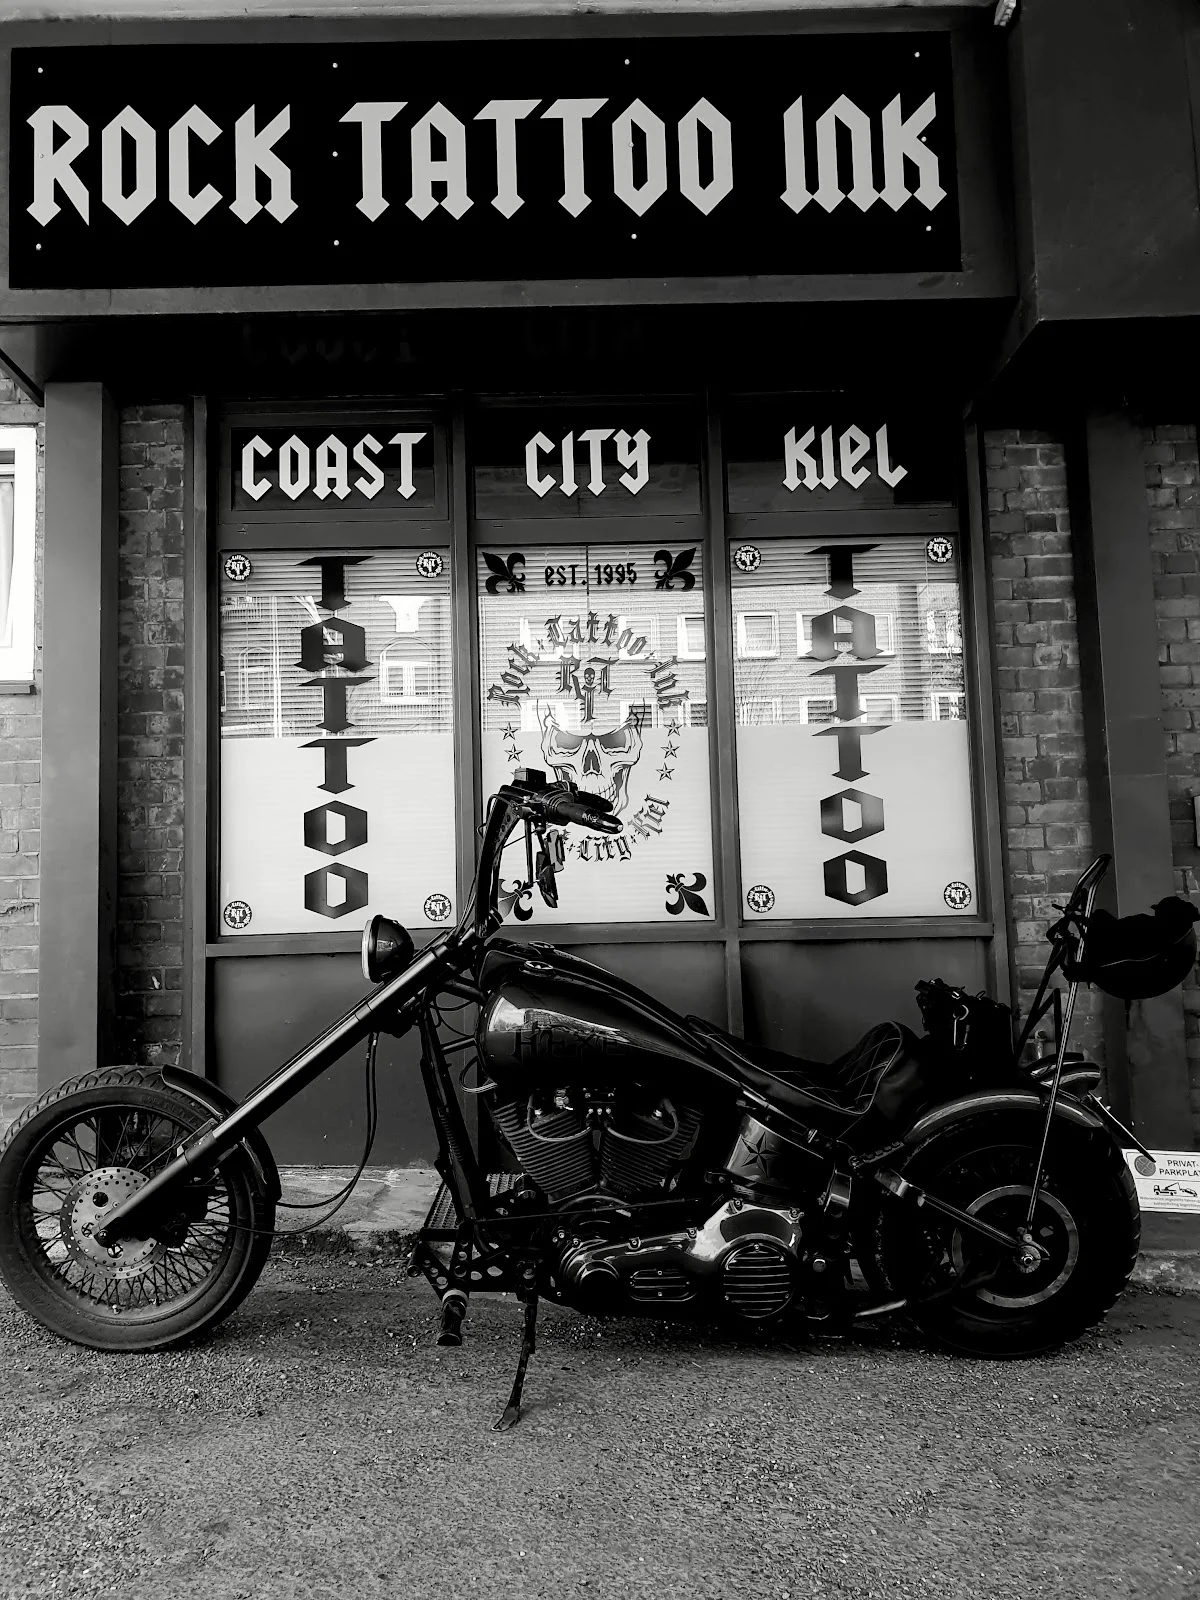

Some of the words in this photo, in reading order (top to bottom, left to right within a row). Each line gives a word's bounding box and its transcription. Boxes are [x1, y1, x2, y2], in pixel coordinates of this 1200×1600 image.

[26, 103, 299, 227] ROCK
[338, 97, 734, 223] TATTOO
[780, 92, 948, 215] INK
[241, 432, 428, 502] COAST
[525, 428, 652, 498] CITY
[594, 562, 638, 585] 1995
[543, 610, 648, 657] Tattoo
[293, 556, 380, 919] TATTOO
[803, 544, 893, 907] TATTOO
[1167, 1159, 1200, 1168] PRIVAT-
